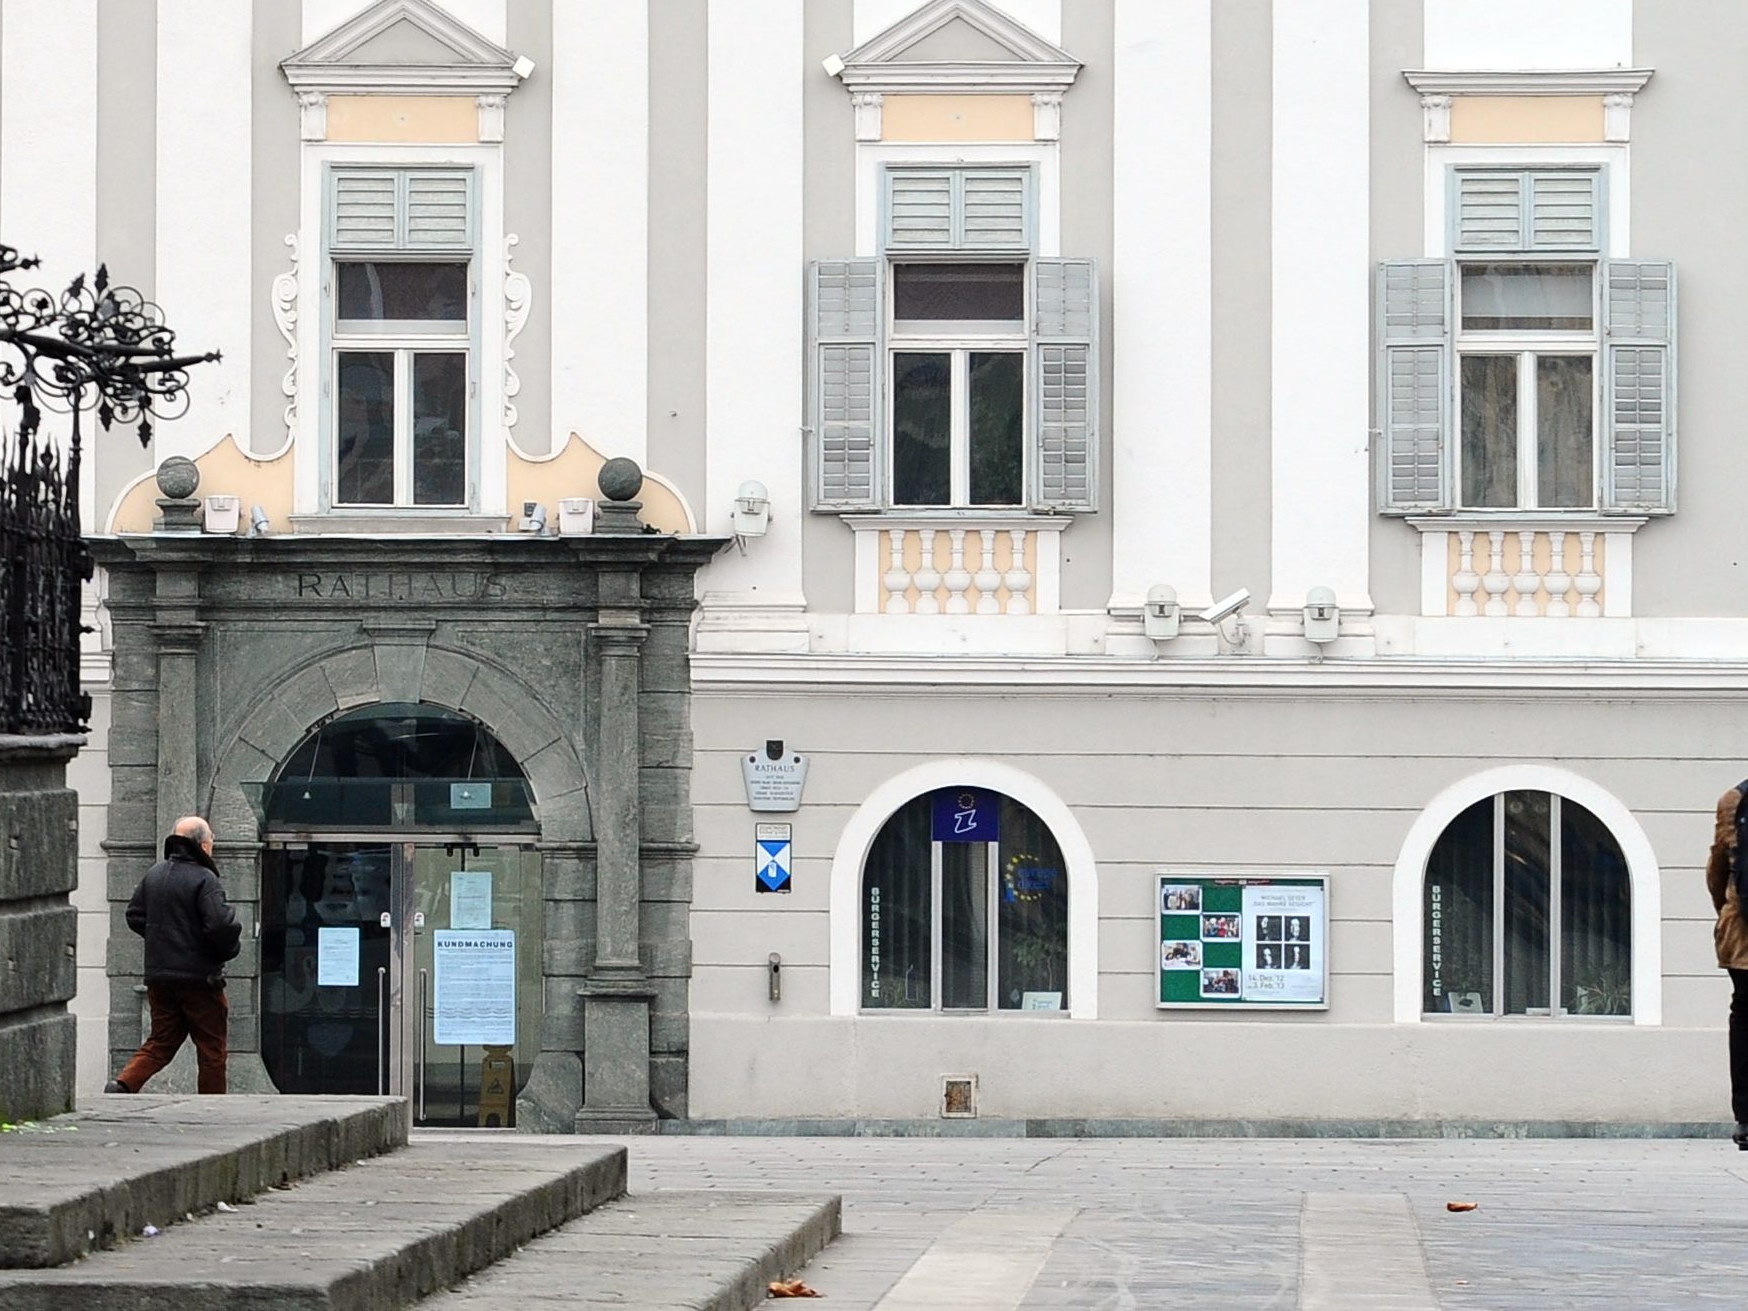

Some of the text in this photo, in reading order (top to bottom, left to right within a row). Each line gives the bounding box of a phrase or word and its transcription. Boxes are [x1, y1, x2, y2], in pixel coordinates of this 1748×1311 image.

[297, 573, 508, 598] RATHAUS
[754, 764, 796, 773] RATHAUS
[437, 940, 514, 949] KUNDMACHUNG
